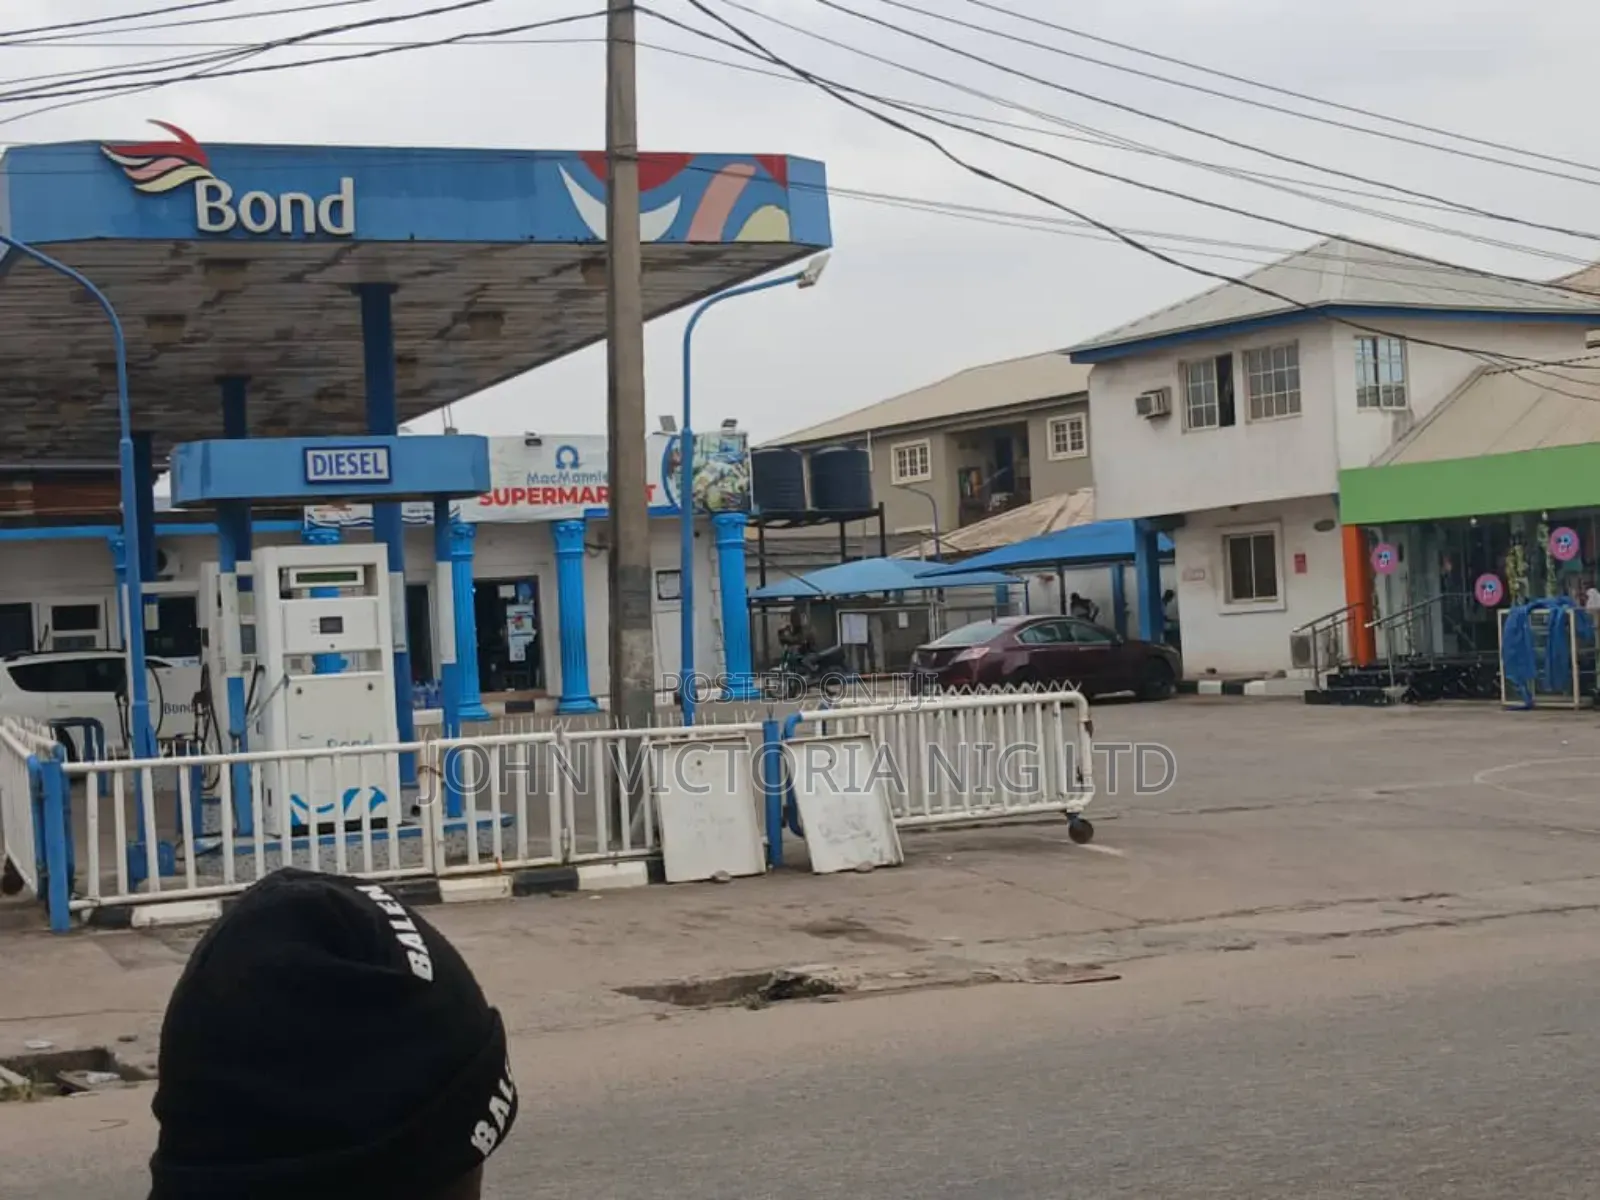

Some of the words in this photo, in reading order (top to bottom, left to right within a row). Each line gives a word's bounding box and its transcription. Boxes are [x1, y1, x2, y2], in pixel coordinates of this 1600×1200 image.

[195, 177, 355, 236] Bond
[311, 451, 384, 477] DIESEL
[478, 484, 656, 506] SUPERMART
[471, 1051, 515, 1157] BAL
